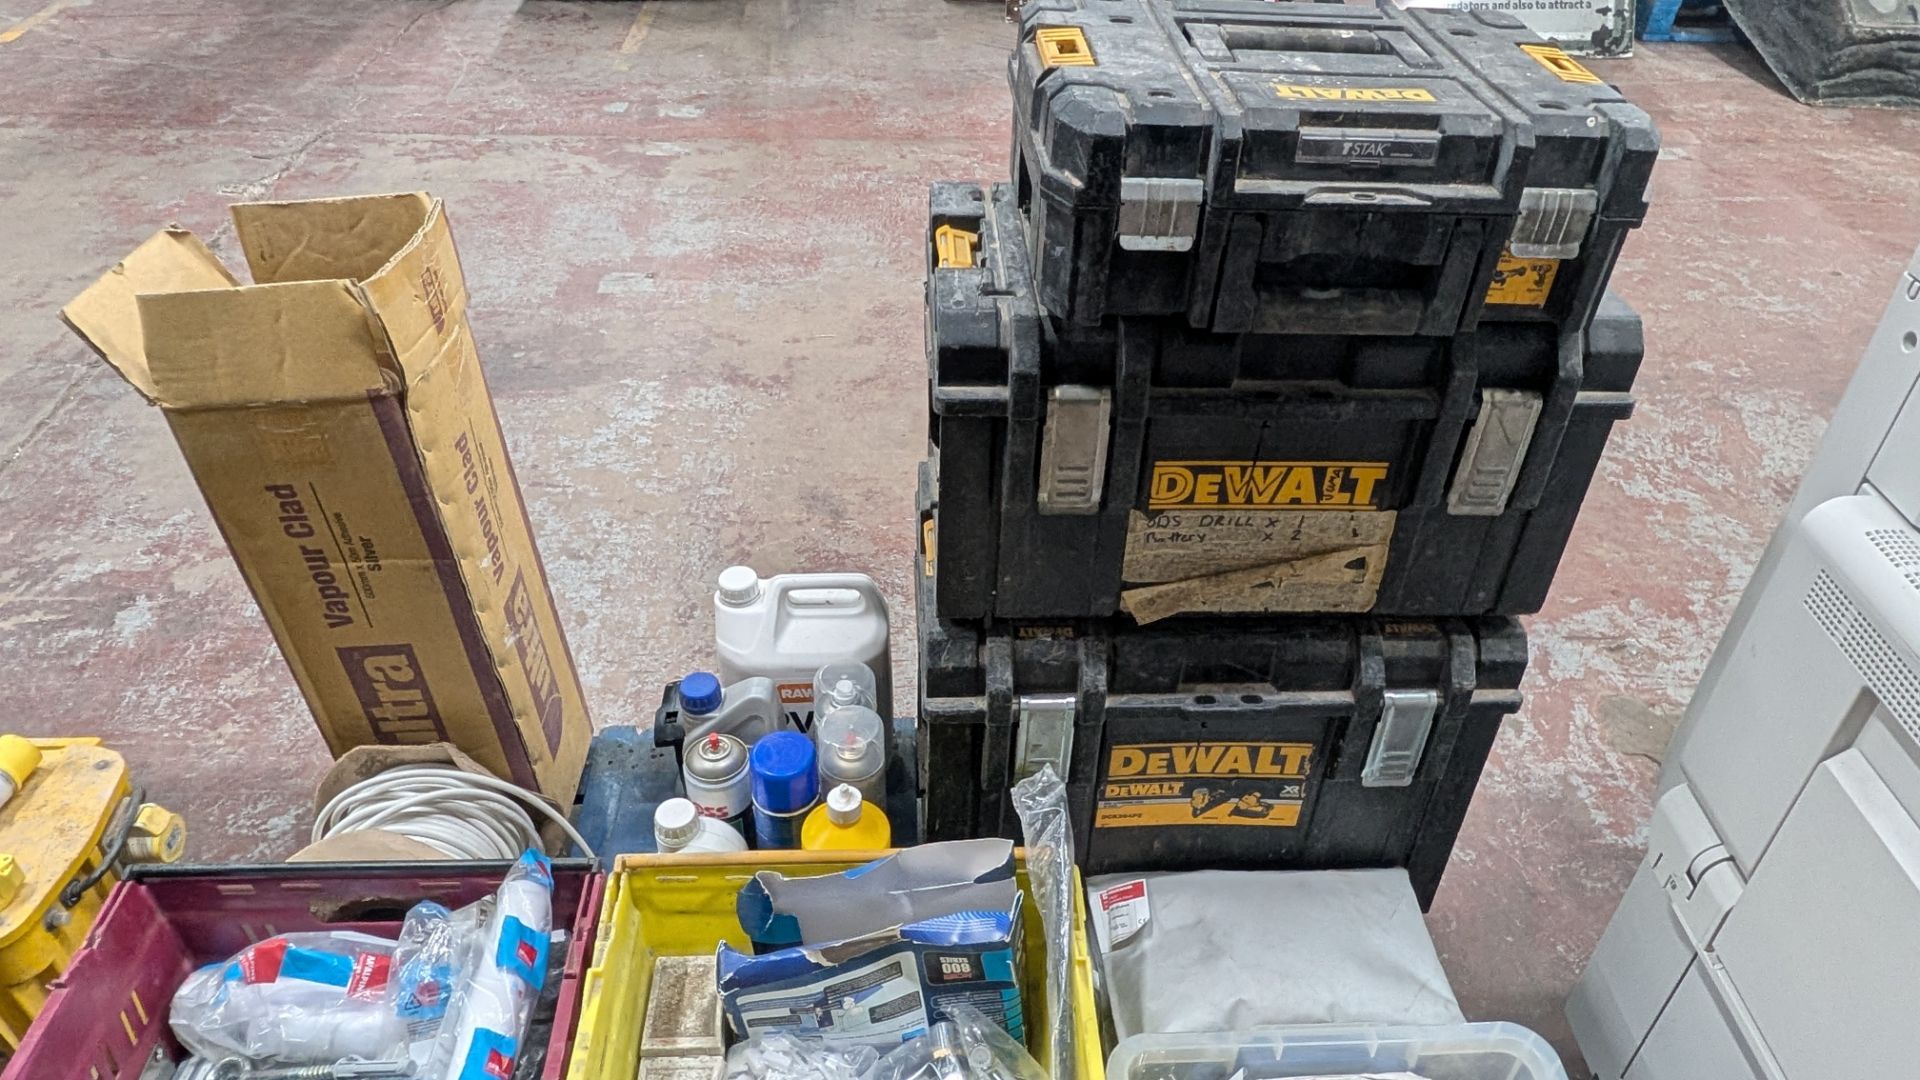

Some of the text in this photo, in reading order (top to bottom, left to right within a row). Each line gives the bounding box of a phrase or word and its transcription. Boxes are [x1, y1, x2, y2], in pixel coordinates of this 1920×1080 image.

[1491, 0, 1510, 10] and
[1512, 0, 1534, 10] also
[1535, 0, 1547, 9] to
[1548, 0, 1585, 9] attract
[1586, 1, 1592, 9] a
[1275, 85, 1436, 102] DEWALT
[453, 431, 478, 494] Clad
[1150, 464, 1388, 505] DEWALT
[1199, 514, 1254, 528] DRILL
[474, 499, 505, 586] Vapour
[1291, 529, 1301, 540] 2
[264, 484, 354, 629] Vapour Clad
[359, 535, 382, 572] Silver
[1108, 744, 1313, 777] DEWALT
[1104, 782, 1184, 798] DEWALT
[941, 963, 971, 974] 800
